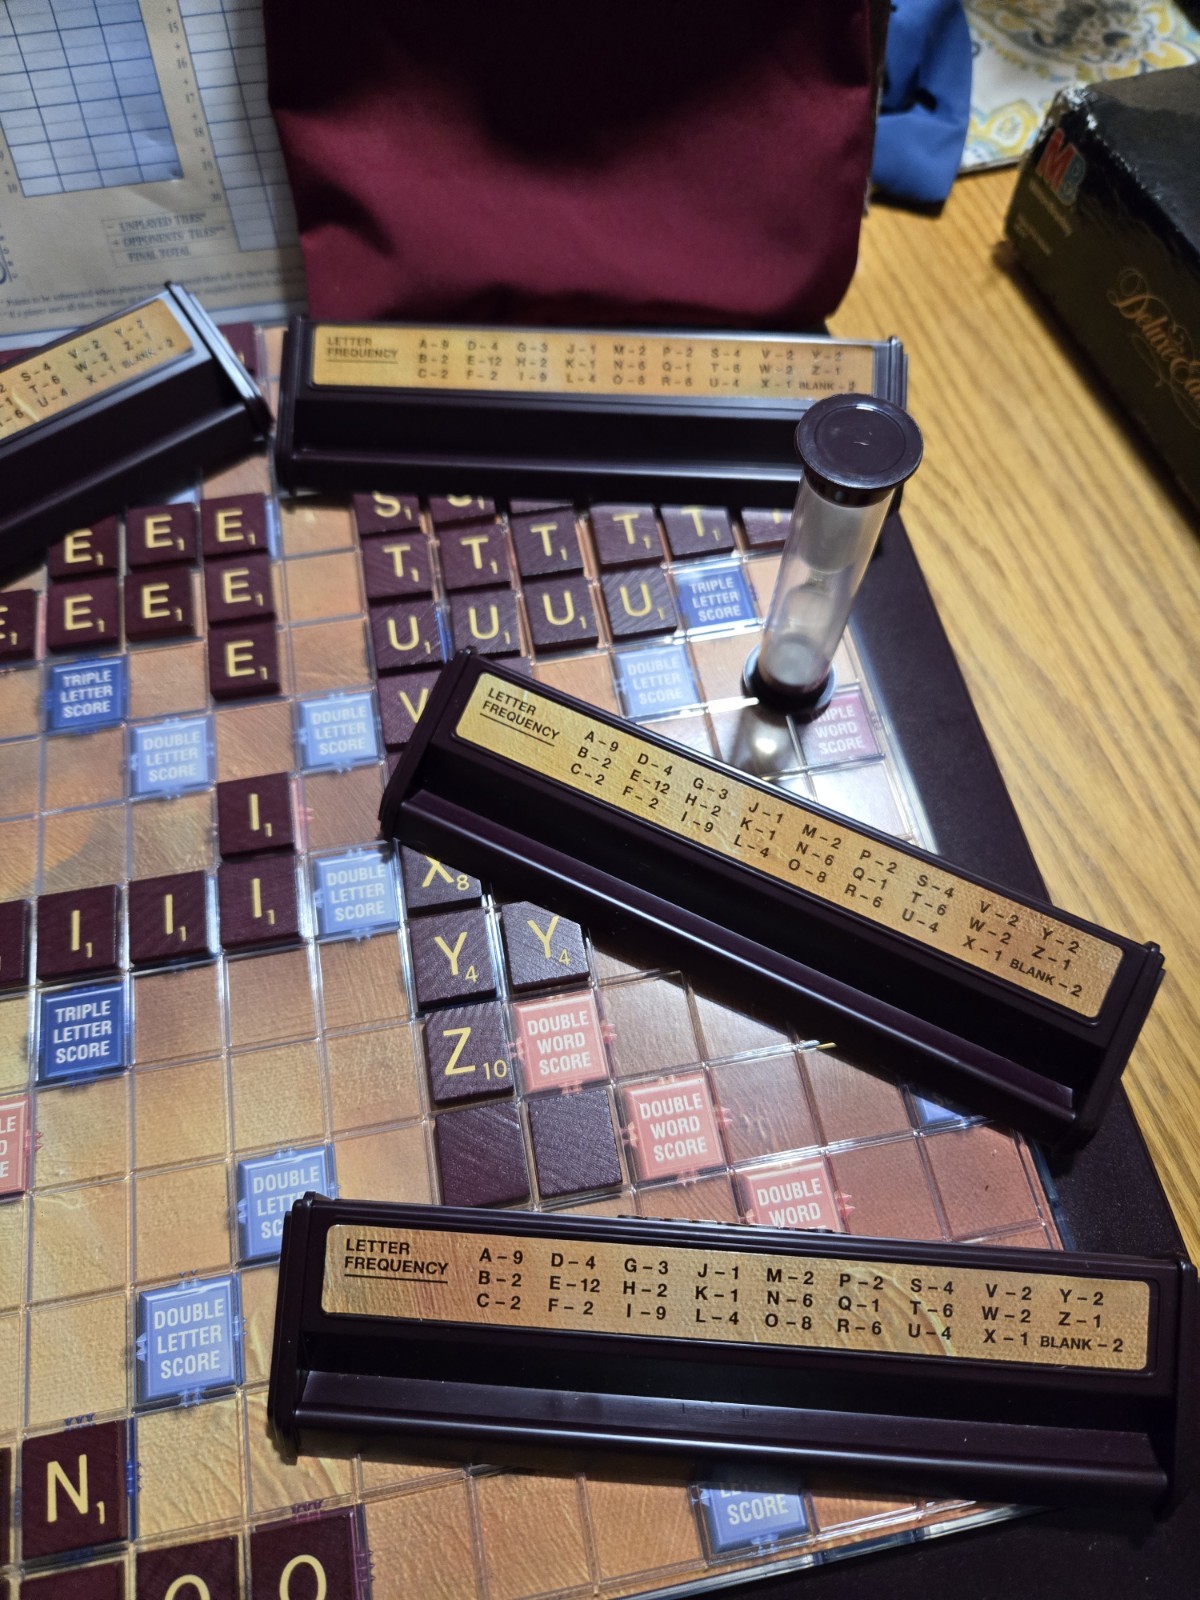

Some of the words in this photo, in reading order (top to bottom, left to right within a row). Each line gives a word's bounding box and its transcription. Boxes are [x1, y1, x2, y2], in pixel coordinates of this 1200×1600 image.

[691, 577, 734, 593] TRIPLE
[692, 591, 740, 608] LETTER
[698, 606, 742, 621] SCORE
[627, 657, 679, 677] DOUBLE
[62, 670, 112, 688] TRIPLE
[633, 673, 681, 690] LETTER
[60, 685, 112, 702] LETTER
[488, 687, 536, 716] LETTER
[638, 689, 683, 705] SCORE
[63, 701, 111, 717] SCORE
[312, 707, 366, 725] DOUBLE
[482, 701, 560, 739] FREQUENCY
[815, 721, 858, 738] WORD
[143, 732, 200, 751] DOUBLE
[316, 723, 366, 741] LETTER
[319, 739, 366, 756] SCORE
[818, 736, 864, 754] SCORE
[145, 749, 198, 766] LETTER
[148, 764, 197, 782] SCORE
[326, 864, 385, 886] DOUBLE
[330, 883, 385, 904] LETTER
[334, 901, 384, 922] SCORE
[55, 1000, 111, 1023] TRIPLE
[53, 1020, 112, 1044] LETTER
[528, 1010, 588, 1035] DOUBLE
[55, 1042, 110, 1064] SCORE
[536, 1033, 585, 1055] WORD
[539, 1052, 591, 1076] SCORE
[639, 1094, 703, 1120] DOUBLE
[650, 1116, 700, 1138] WORD
[653, 1137, 708, 1162] SCORE
[253, 1166, 320, 1194] DOUBLE
[756, 1178, 822, 1206] DOUBLE
[257, 1190, 304, 1217] LETT
[768, 1203, 821, 1227] WORD
[346, 1239, 410, 1255] LETTER
[345, 1256, 449, 1275] FREQUENCY
[154, 1298, 225, 1329] DOUBLE
[157, 1325, 222, 1354] LETTER
[160, 1350, 221, 1379] SCORE
[727, 1494, 789, 1525] SCORE
